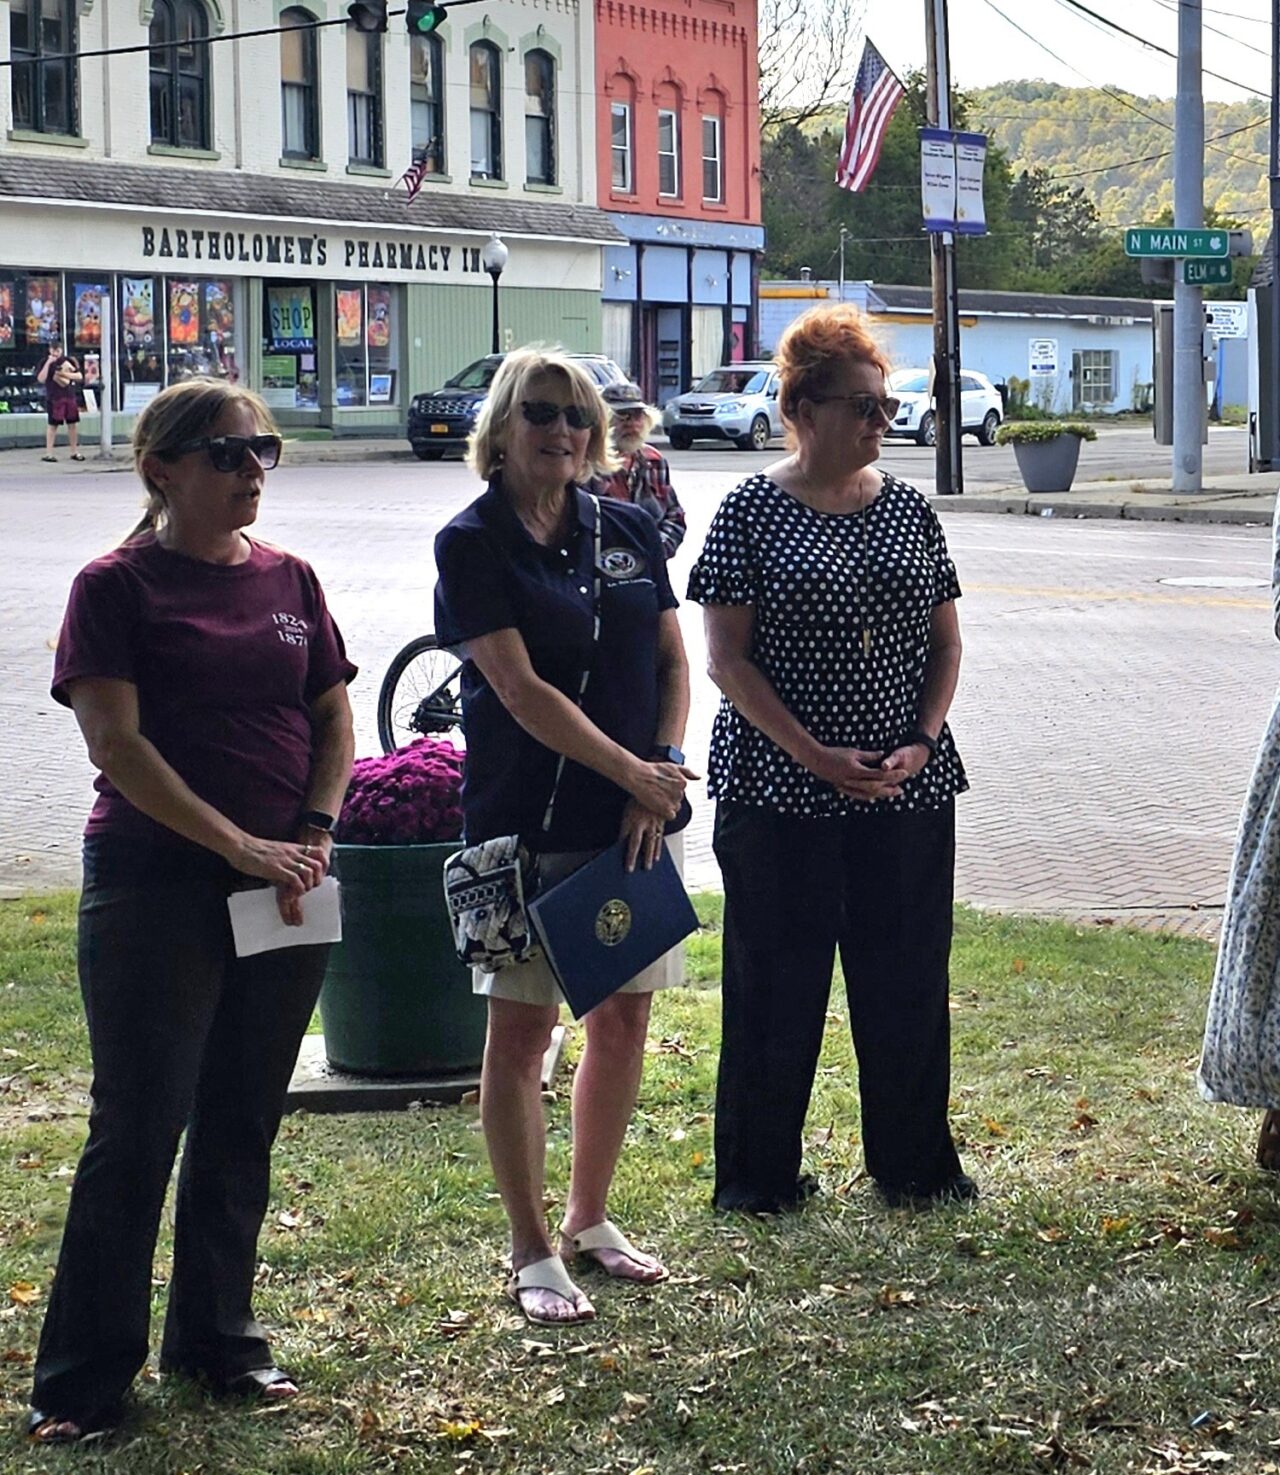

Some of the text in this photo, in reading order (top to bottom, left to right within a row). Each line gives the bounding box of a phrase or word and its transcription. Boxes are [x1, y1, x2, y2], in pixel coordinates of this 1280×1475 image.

[142, 226, 489, 273] BARTHOLOMEW'S PHARMACY IN
[1131, 234, 1203, 250] N MAIN ST
[1188, 264, 1207, 279] ELM
[272, 306, 311, 330] SHOP
[274, 339, 313, 348] LOCAL
